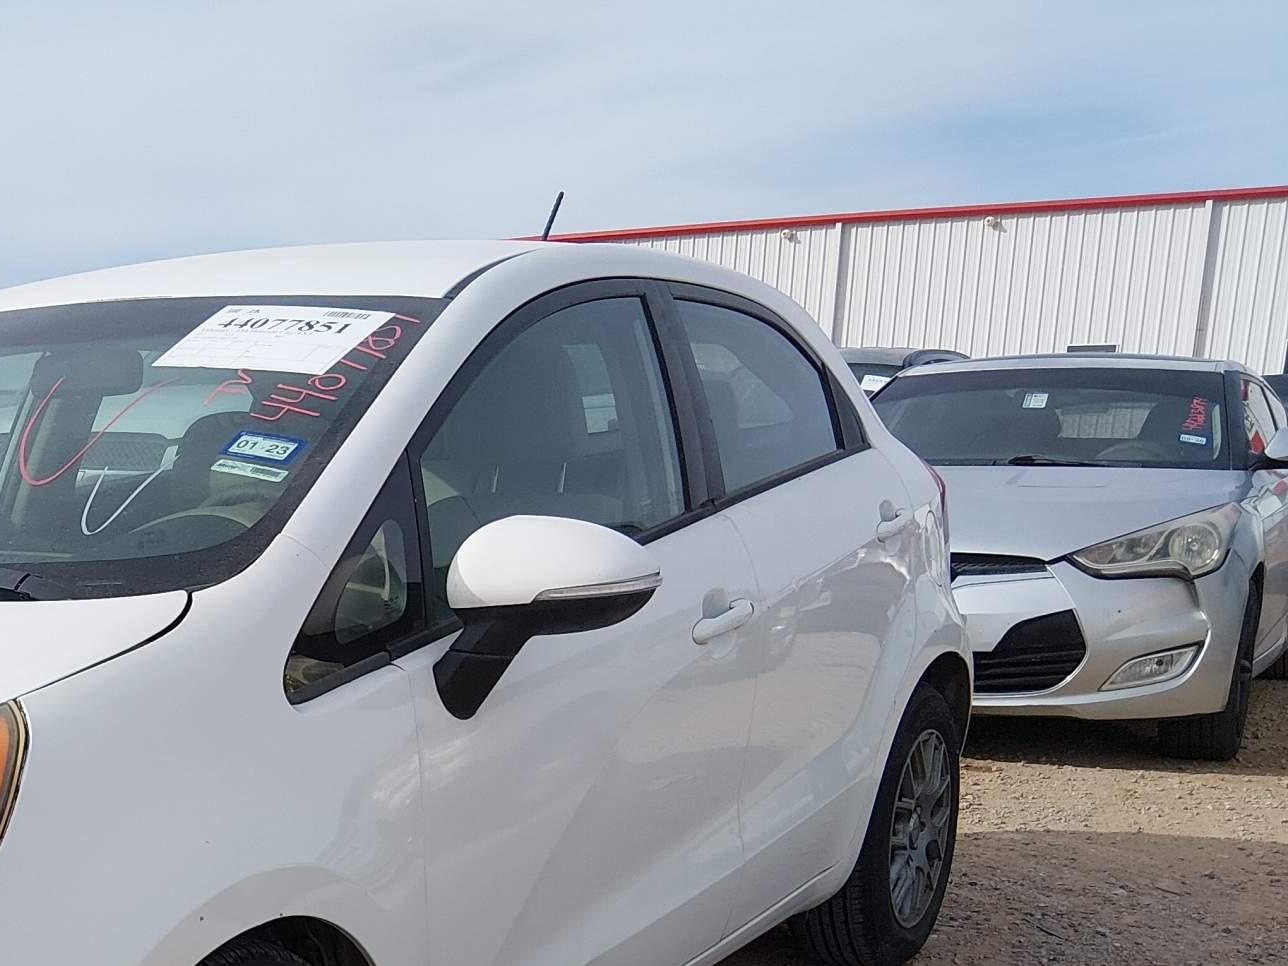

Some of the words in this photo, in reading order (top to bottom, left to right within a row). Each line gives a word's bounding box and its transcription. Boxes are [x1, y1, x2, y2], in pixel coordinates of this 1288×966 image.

[217, 317, 353, 335] 44077851
[236, 439, 258, 450] 01
[265, 443, 291, 455] 23
